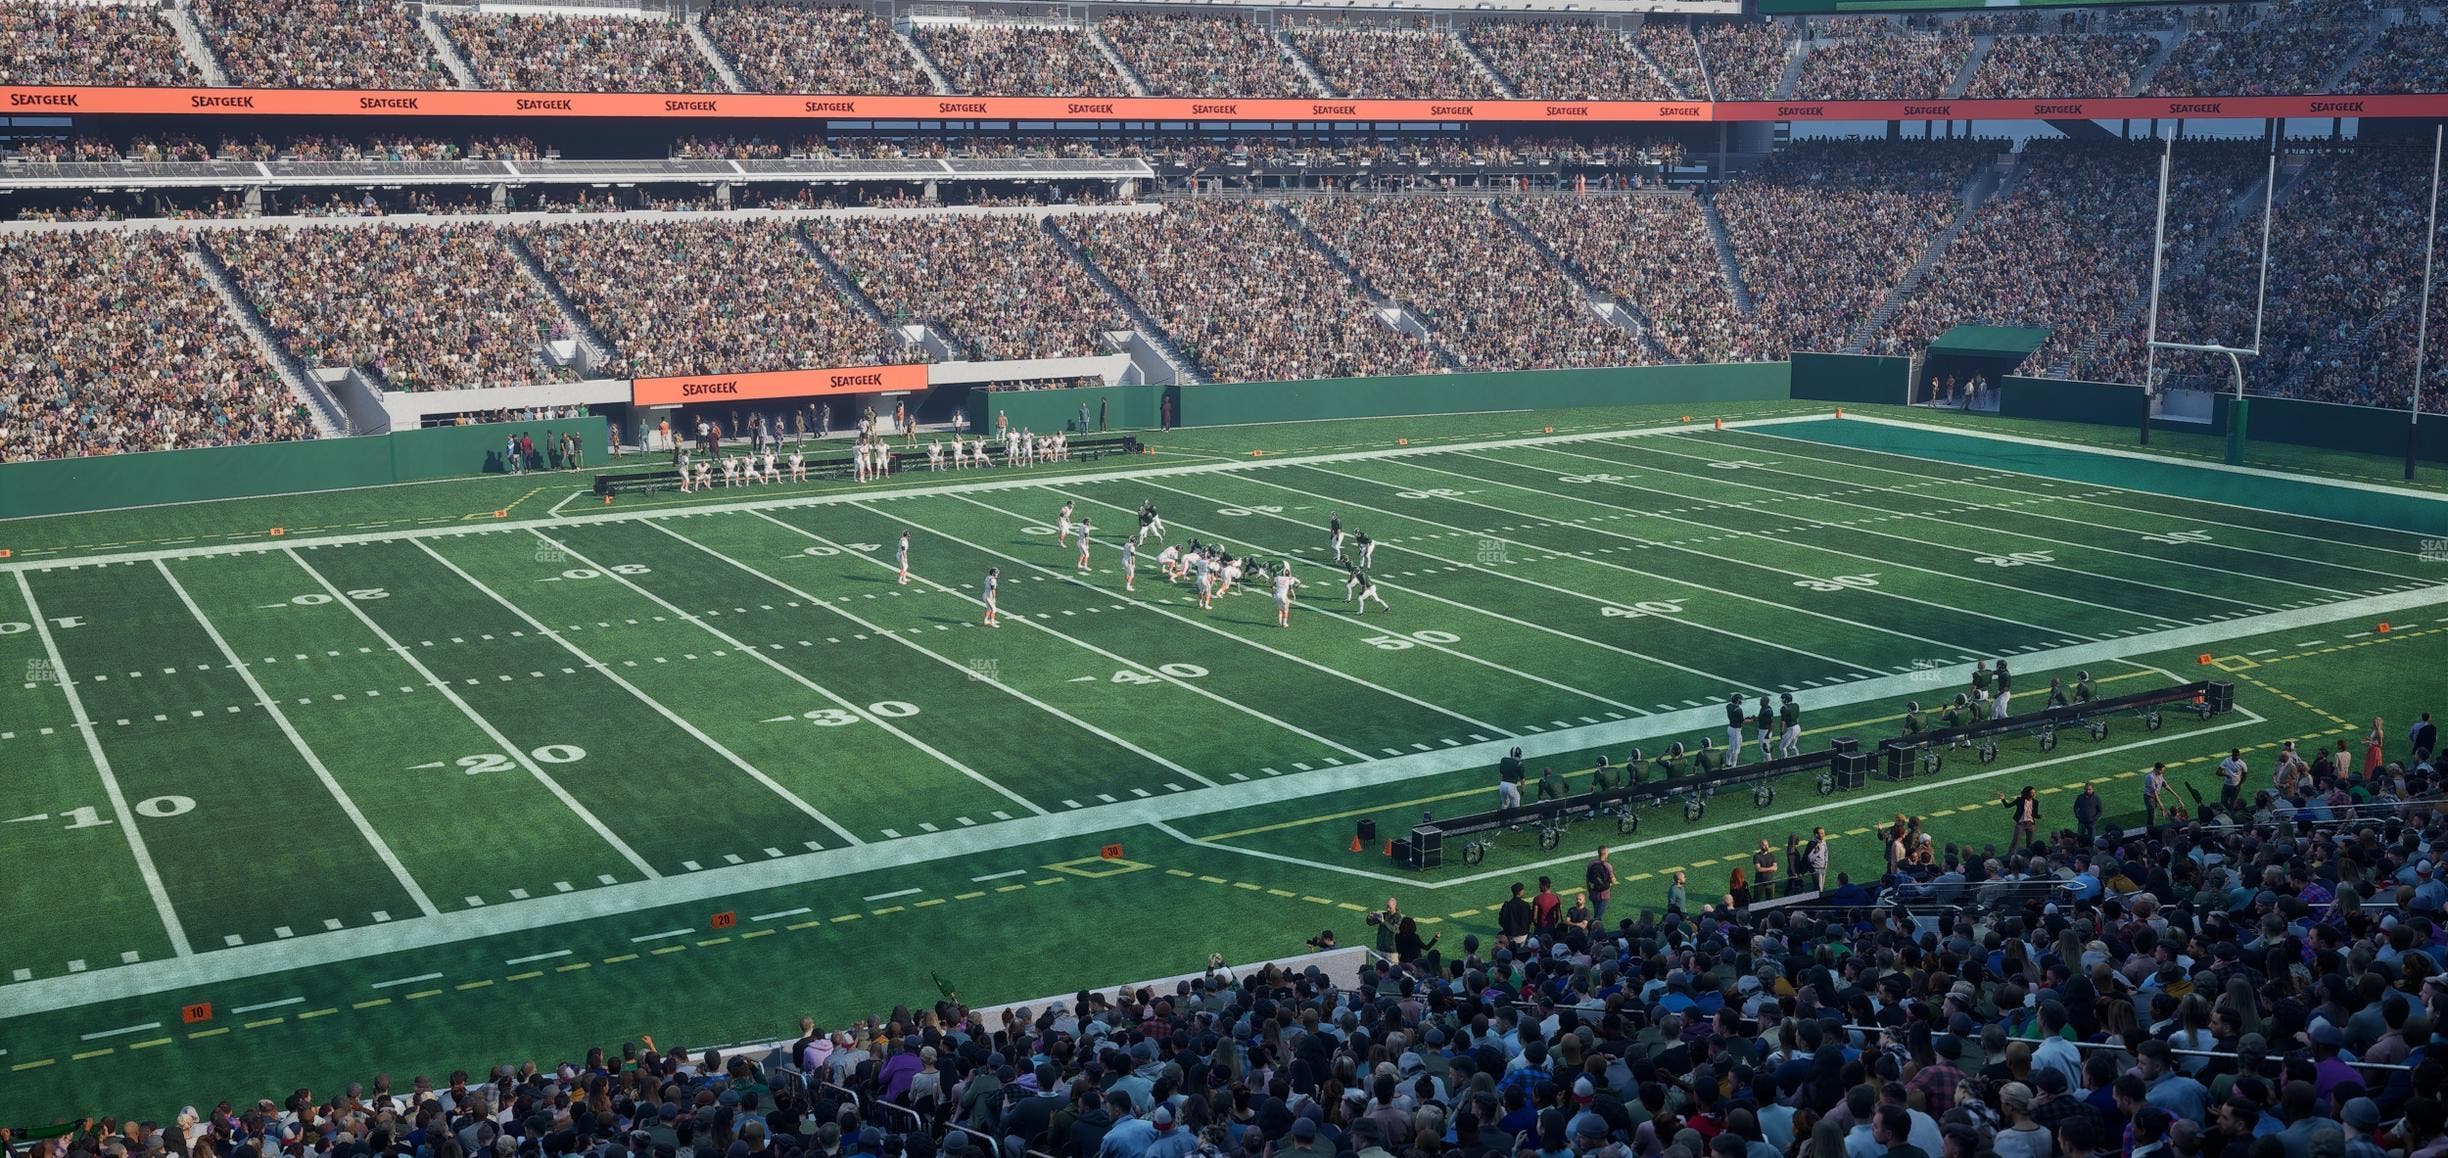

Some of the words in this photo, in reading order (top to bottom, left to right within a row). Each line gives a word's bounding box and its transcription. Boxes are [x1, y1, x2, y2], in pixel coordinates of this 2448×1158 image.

[11, 94, 79, 106] SEATGEEK
[192, 96, 254, 107] SEATGEEK
[360, 97, 418, 109] SEATGEEK
[516, 99, 572, 110] SEATGEEK
[665, 101, 717, 111] SEATGEEK
[805, 102, 855, 112] SEATGEEK
[939, 103, 987, 113] SEATGEEK
[1068, 104, 1114, 114] SEATGEEK
[1192, 104, 1237, 114] SEATGEEK
[1312, 105, 1357, 115] SEATGEEK
[1432, 106, 1474, 116] SEATGEEK
[1547, 106, 1589, 116] SEATGEEK
[1778, 107, 1824, 116] SEATGEEK
[1903, 106, 1951, 115] SEATGEEK
[2034, 104, 2083, 114] SEATGEEK
[2169, 103, 2221, 113] SEATGEEK
[2310, 102, 2364, 112] SEATGEEK
[1659, 107, 1701, 117] SEATGEEK
[830, 373, 882, 388] SEATGEEK
[682, 381, 738, 396] SEATGEEK
[1793, 575, 1879, 591] 30
[1600, 601, 1683, 618] 40
[1359, 629, 1461, 650] 50
[1110, 663, 1209, 685] 40
[803, 701, 920, 726] 30
[455, 744, 587, 775] 20
[60, 795, 197, 830] 10
[1107, 846, 1119, 857] 30
[718, 914, 730, 926] 20
[191, 1006, 204, 1018] 10
